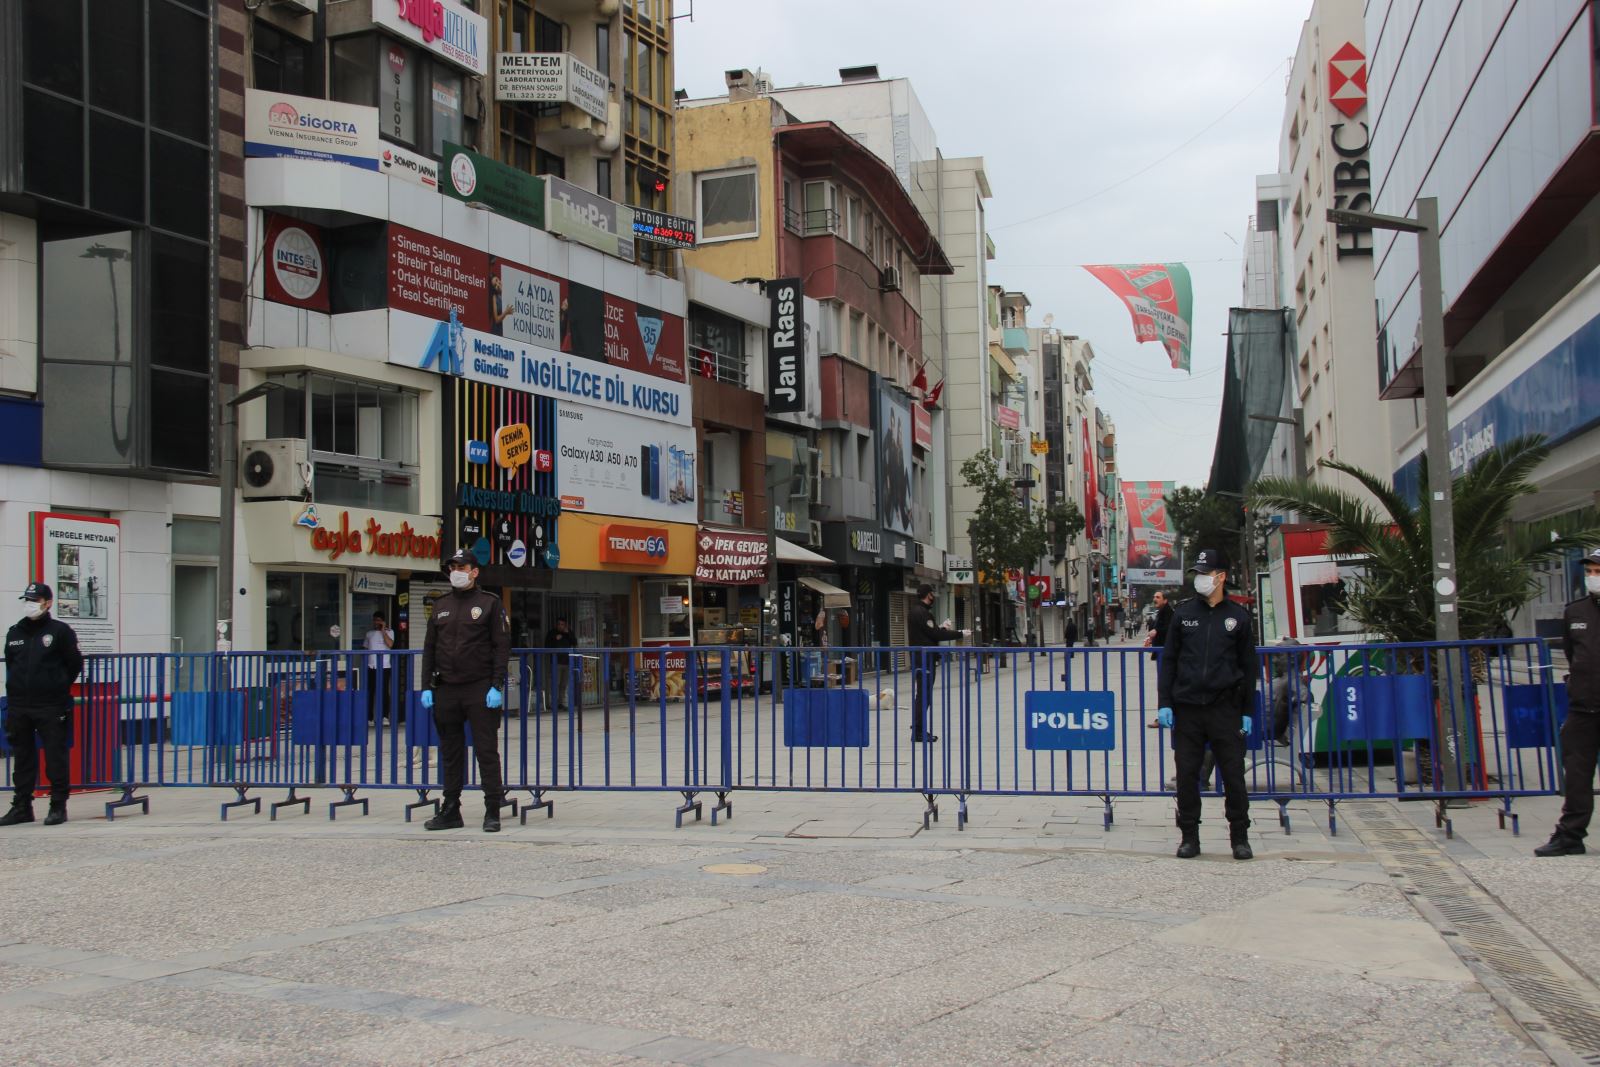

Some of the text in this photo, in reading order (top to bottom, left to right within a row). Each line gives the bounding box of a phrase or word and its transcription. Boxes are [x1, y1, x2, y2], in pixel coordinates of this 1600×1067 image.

[390, 52, 404, 66] RAY
[502, 56, 560, 67] MELTEM
[573, 62, 606, 89] MELTEM
[300, 114, 357, 134] SİGORTA
[394, 155, 436, 178] SOMPO JAPAN
[1330, 122, 1373, 262] HSBC
[635, 210, 662, 227] RTDIŞI
[668, 216, 694, 234] EĞİTİM
[660, 228, 674, 237] 369
[674, 231, 683, 240] 92
[685, 233, 693, 242] 72
[398, 235, 461, 266] Sinema Salonu
[398, 252, 486, 288] Birebir Telafi Dersleri
[398, 270, 468, 300] Ortak Kütüphane
[518, 281, 554, 306] 4 AYDA
[398, 285, 465, 315] Tesol Sertifikası
[514, 297, 554, 323] İNGİLİZCE
[604, 302, 624, 322] İZCE
[513, 320, 554, 341] KONUŞUN
[644, 326, 656, 345] 35
[474, 339, 514, 362] Neslihan
[774, 286, 796, 402] Jan Rass
[474, 359, 509, 380] Gündüz
[521, 351, 679, 416] İNGİLİZCE DİL KURSU
[559, 409, 584, 421] SAMSUNG
[501, 428, 523, 446] TEKNİK
[470, 447, 488, 457] KVK
[507, 439, 528, 459] SERVİS
[561, 445, 638, 468] Galaxy A30 A50 A70
[463, 484, 514, 510] Aksesuar
[776, 506, 796, 529] Rass
[50, 530, 116, 543] HERGELE MEYDANI
[313, 511, 443, 560] ayla tantuni
[715, 536, 735, 551] İPEK
[609, 536, 665, 557] TEKNOSA
[698, 555, 768, 566] SALONUMUZ
[696, 566, 714, 578] ÜST
[644, 658, 686, 668] İPEK EVRE
[1031, 708, 1109, 730] POLİS
